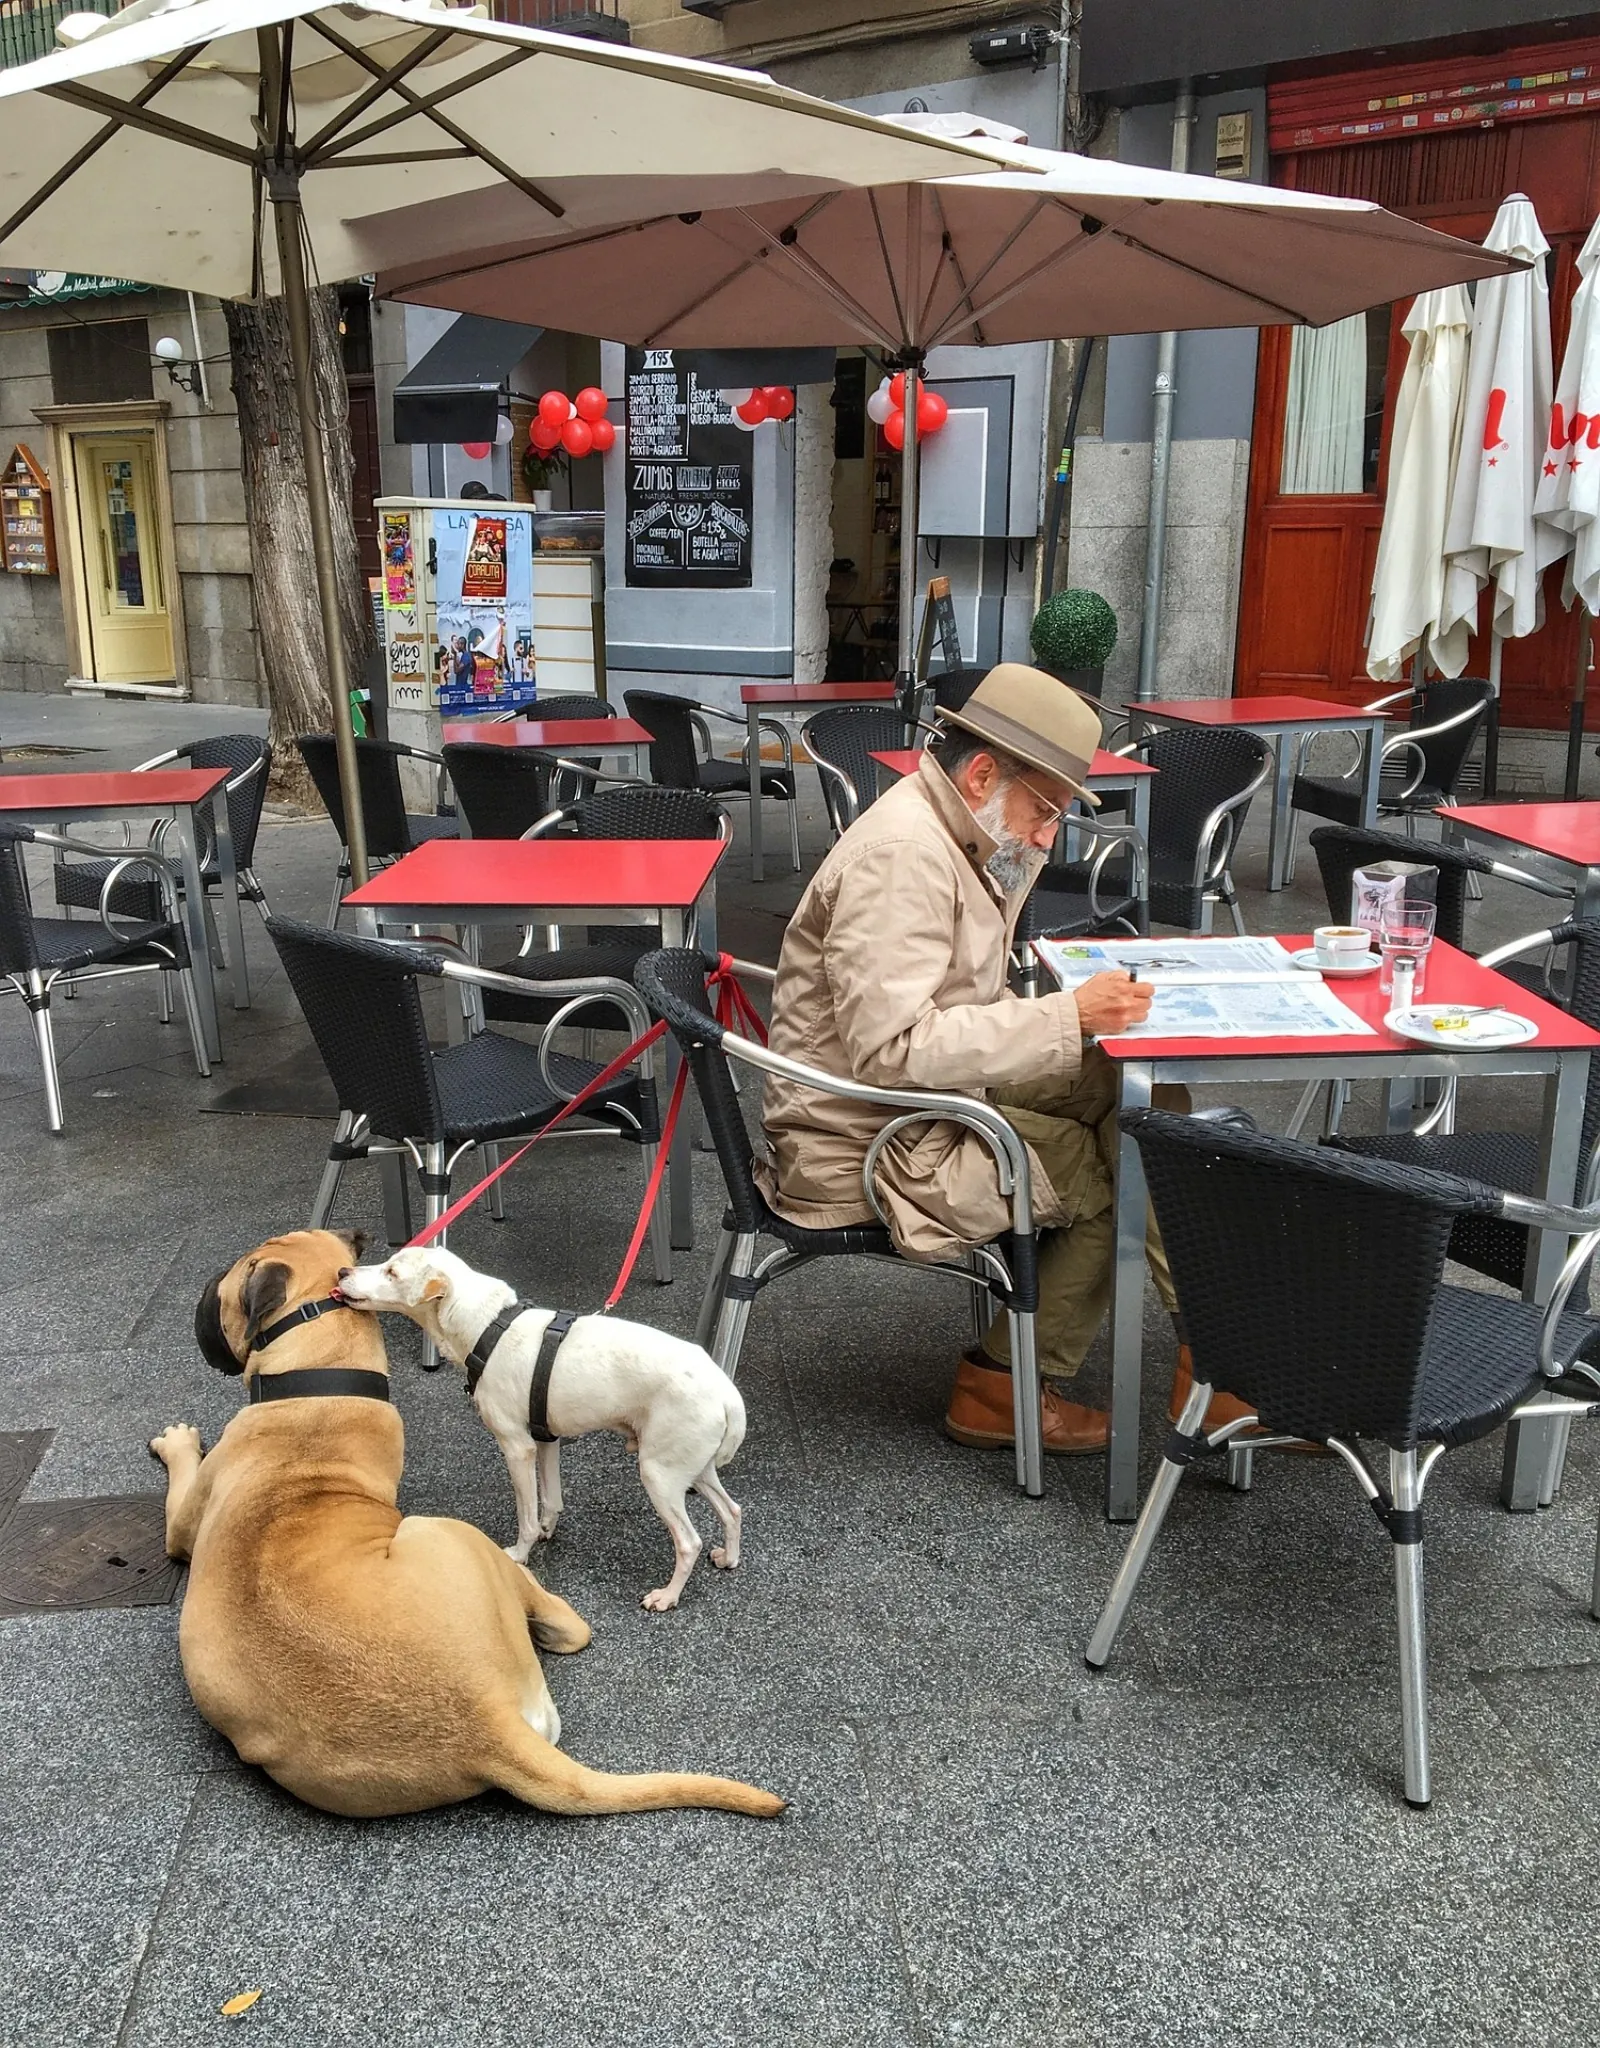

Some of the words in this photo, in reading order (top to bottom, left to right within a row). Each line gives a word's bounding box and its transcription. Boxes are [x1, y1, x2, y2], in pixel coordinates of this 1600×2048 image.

[651, 372, 677, 384] SERRANO
[629, 385, 654, 396] CHORIZO
[652, 396, 656, 405] Y
[657, 395, 677, 405] QUESO
[629, 435, 657, 446] VEGETAL
[633, 465, 673, 491] ZUMOS
[644, 492, 675, 501] NATURAL
[678, 491, 699, 500] FRESH
[692, 535, 719, 548] BOTELLA
[692, 548, 701, 560] DE
[701, 548, 720, 561] AGUA
